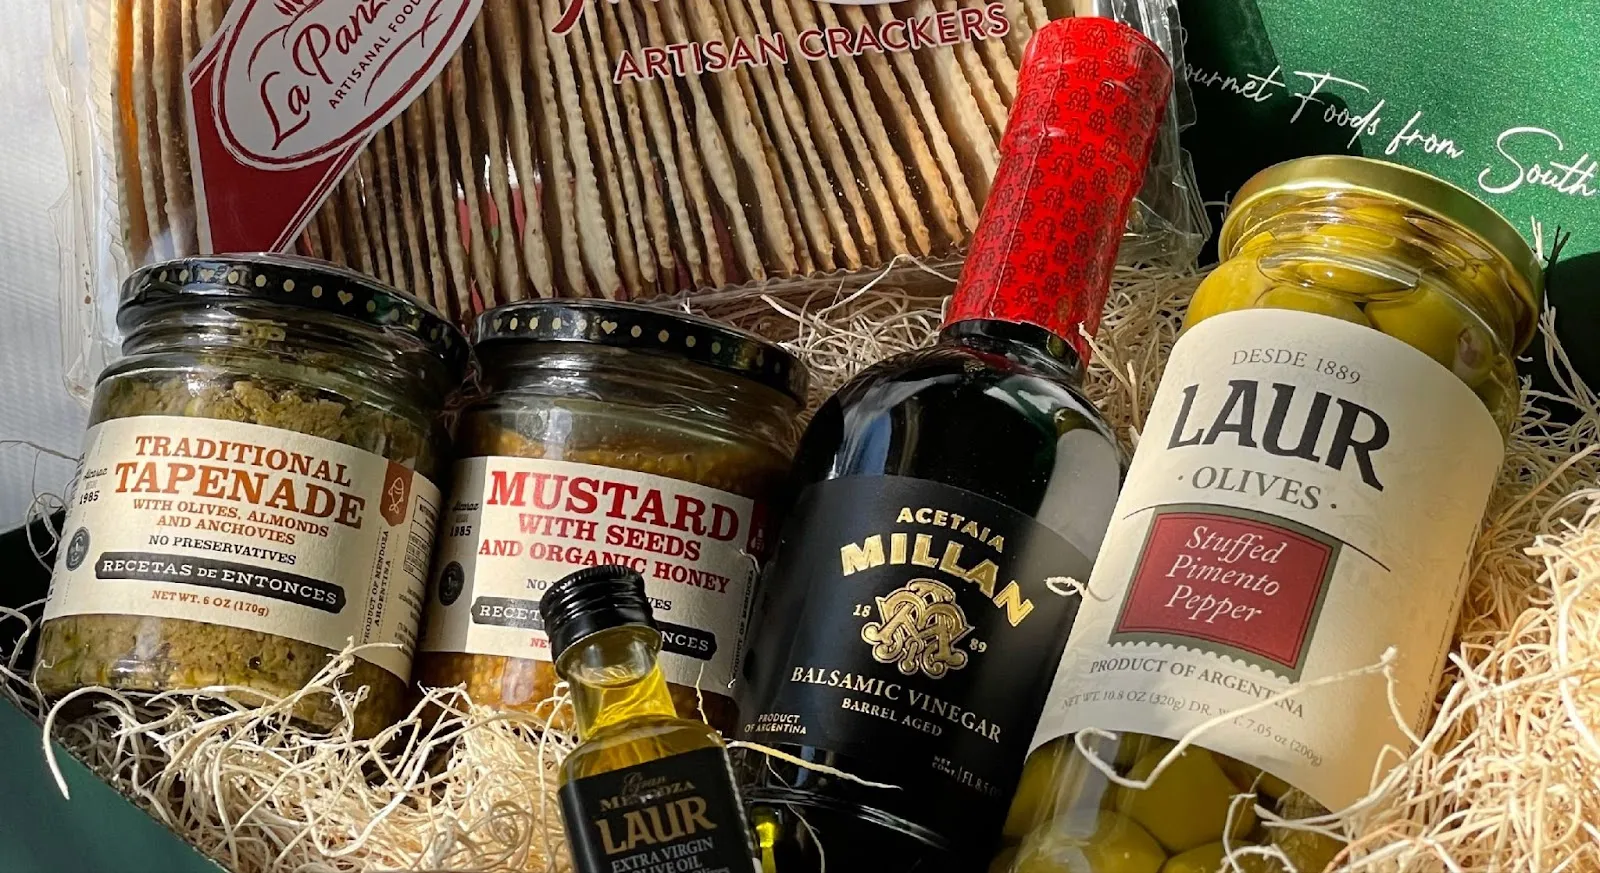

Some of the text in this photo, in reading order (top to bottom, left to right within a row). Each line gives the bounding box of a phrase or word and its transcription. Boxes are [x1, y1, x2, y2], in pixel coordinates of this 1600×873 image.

[613, 2, 1013, 84] ARTISAN CRACKERS
[328, 35, 392, 110] ARTISANAL
[260, 71, 311, 151] La
[1180, 62, 1598, 197] ourmet Foods from South
[1231, 347, 1361, 384] DESDE 1889
[1166, 379, 1391, 492] LAUR
[135, 435, 352, 488] TRADITIONAL
[79, 490, 101, 505] 1985
[114, 461, 366, 530] TAPENADE
[486, 470, 740, 542] MUSTARD
[1192, 466, 1321, 509] OLIVES
[133, 498, 173, 512] WITH
[246, 509, 330, 538] ALMONDS
[156, 515, 297, 545] AND ANCHOVIES
[519, 513, 701, 562] WITH SEEDS
[896, 506, 1005, 554] ACETAIA
[148, 534, 297, 566] NO PRESERVATIVES
[478, 538, 731, 594] AND ORGANIC HONEY
[1184, 525, 1288, 565] Stuffed
[102, 559, 193, 577] RECETAS
[220, 569, 338, 606] ENTONCES
[362, 529, 390, 645] PRODUCT OF MENDOZA
[373, 559, 391, 628] ARGENTINA
[526, 578, 547, 590] NO
[840, 532, 1035, 628] MILLAN
[1165, 554, 1281, 597] Pimento
[151, 590, 271, 618] NET WT. 6 OZ (170g)
[479, 605, 545, 623] RECET
[1164, 584, 1263, 624] Pepper
[530, 637, 550, 649] NE
[852, 603, 988, 653] 18 89
[1089, 657, 1168, 675] PRODUCT
[1170, 662, 1196, 678] OF
[757, 713, 801, 724] PRODUCT
[790, 666, 1002, 744] BALSAMIC VINEGAR
[841, 697, 943, 737] BARREL AGED
[743, 722, 808, 735] OF ARGENTINA
[1103, 690, 1124, 701] 10.8
[1126, 690, 1146, 702] OZ
[1149, 691, 1186, 712] (320g)
[1188, 700, 1213, 716] DR.
[1246, 718, 1272, 738] 7.05
[1290, 739, 1323, 768] (200g)
[595, 796, 719, 856] LAUR
[611, 836, 714, 873] EXTRA VIRGIN
[676, 855, 703, 873] OIL
